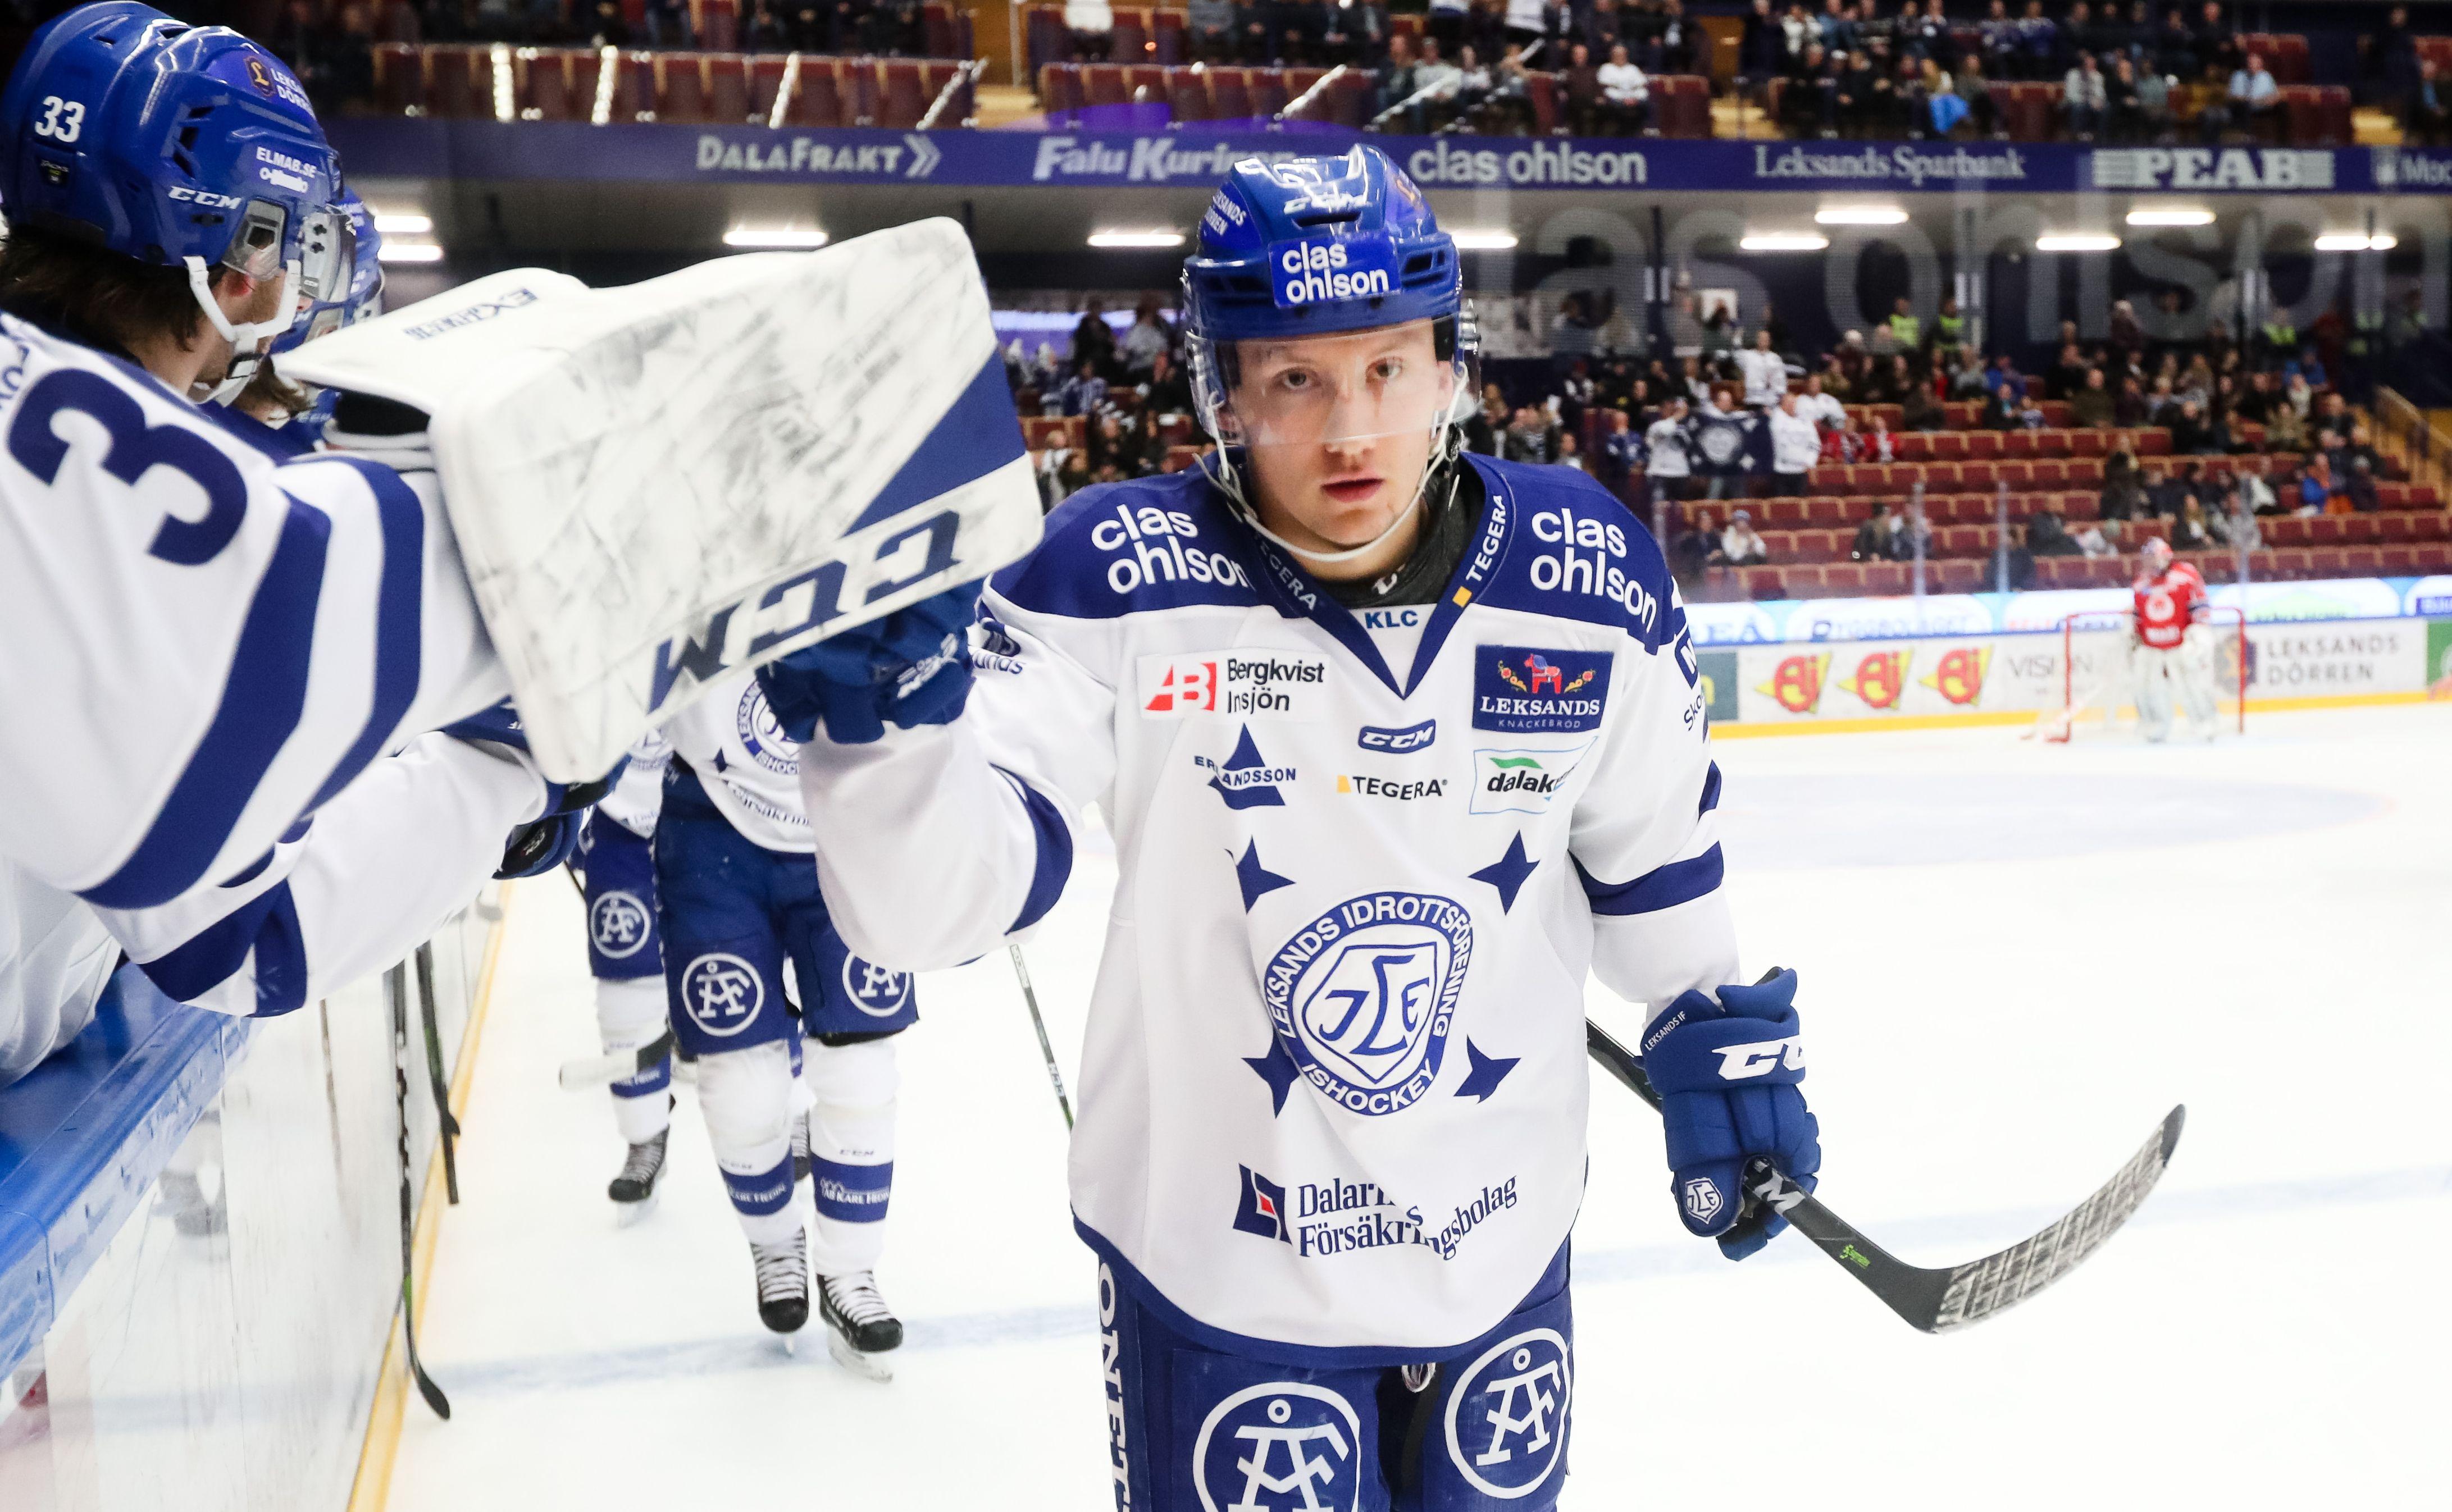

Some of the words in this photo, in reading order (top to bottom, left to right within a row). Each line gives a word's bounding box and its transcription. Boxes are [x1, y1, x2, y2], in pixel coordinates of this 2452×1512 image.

[34, 95, 85, 143] 33
[1408, 139, 1500, 183] clas
[1506, 140, 1648, 185] ohlson
[1753, 144, 1890, 178] Leksands
[2135, 148, 2301, 189] PEAB
[168, 186, 241, 210] CCM
[1282, 241, 1347, 274] clas
[1286, 268, 1389, 304] ohlson
[8, 367, 248, 567] 3
[1091, 504, 1198, 551] clas
[1465, 495, 1507, 582] TEGERA
[1531, 508, 1627, 559] clas
[1529, 546, 1658, 634] ohlson
[1364, 610, 1419, 629] KLC
[2267, 632, 2401, 659] LEKSANDS
[1227, 658, 1325, 685] Bergkvist
[1227, 687, 1290, 715] Insjön
[1479, 696, 1601, 716] LEKSANDS
[1361, 728, 1433, 749] CCM
[1266, 917, 1341, 1039] LEKSANDS
[1644, 1018, 1681, 1052] LEKSANDS
[1301, 1057, 1435, 1114] ISHOCKEY
